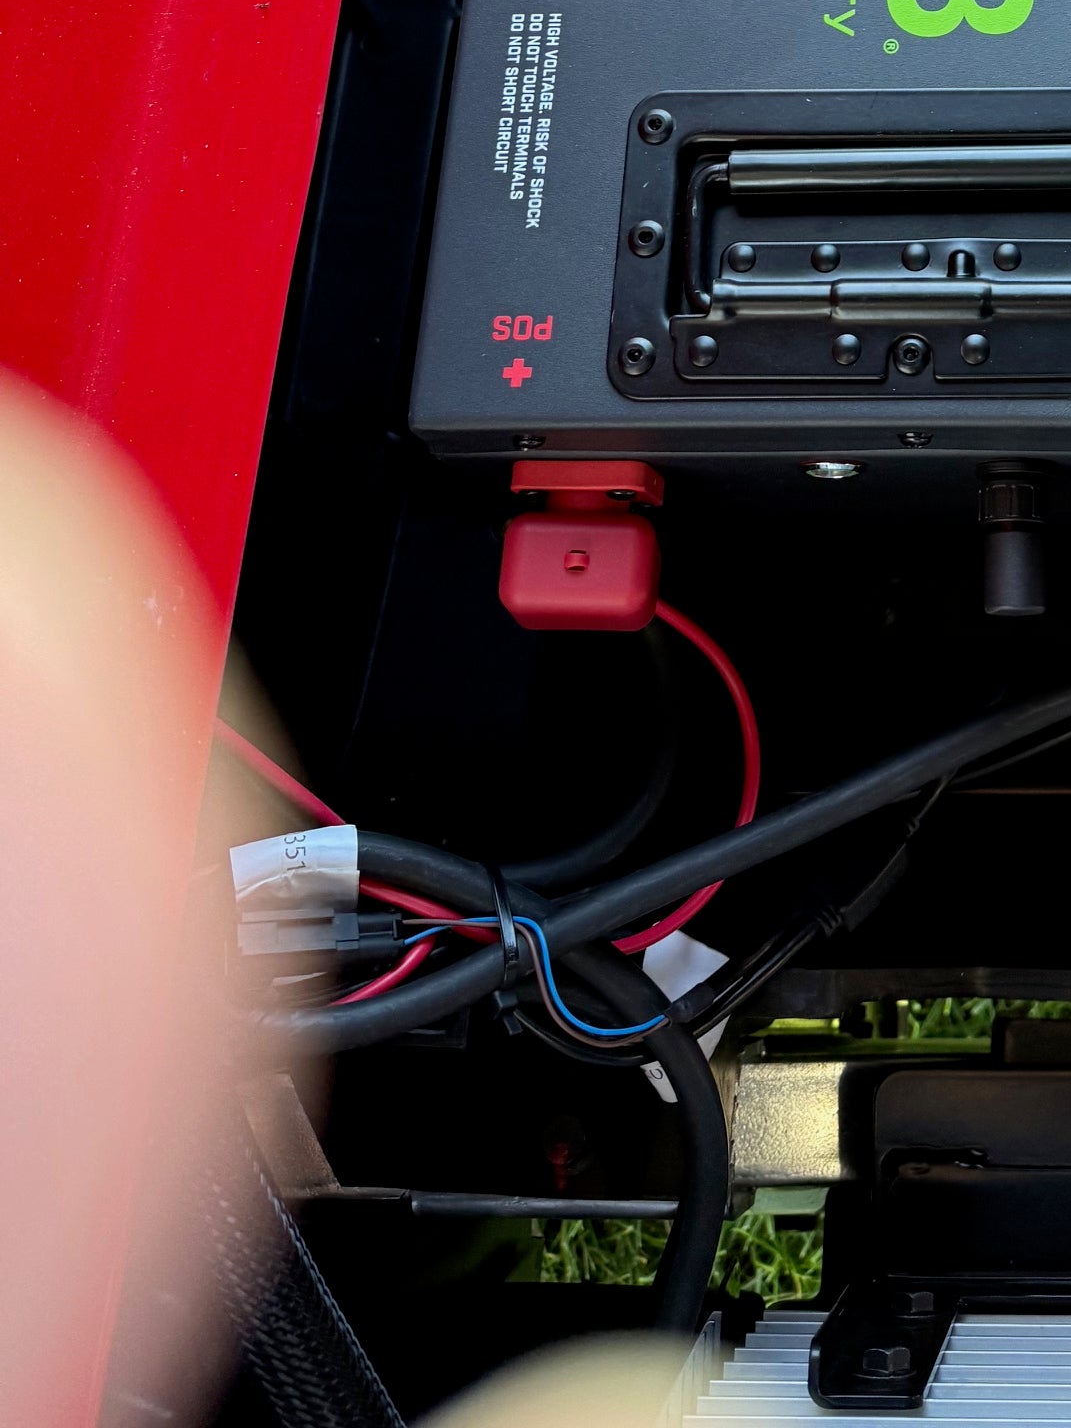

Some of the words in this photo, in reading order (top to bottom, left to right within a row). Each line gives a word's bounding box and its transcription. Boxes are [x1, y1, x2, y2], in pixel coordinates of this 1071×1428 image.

[510, 13, 525, 32] DO
[529, 13, 544, 32] DO
[545, 13, 562, 46] HIGH
[507, 36, 523, 64] NOT
[526, 36, 542, 64] NOT
[501, 67, 519, 113] SHORT
[520, 67, 538, 113] TOUCH
[539, 49, 559, 114] VOLTAGE.
[494, 118, 513, 173] CIRCUIT
[534, 118, 551, 151] RISK
[510, 116, 532, 200] TERMINALS
[532, 156, 547, 174] OF
[525, 178, 544, 228] SHOCK
[491, 314, 553, 341] POS
